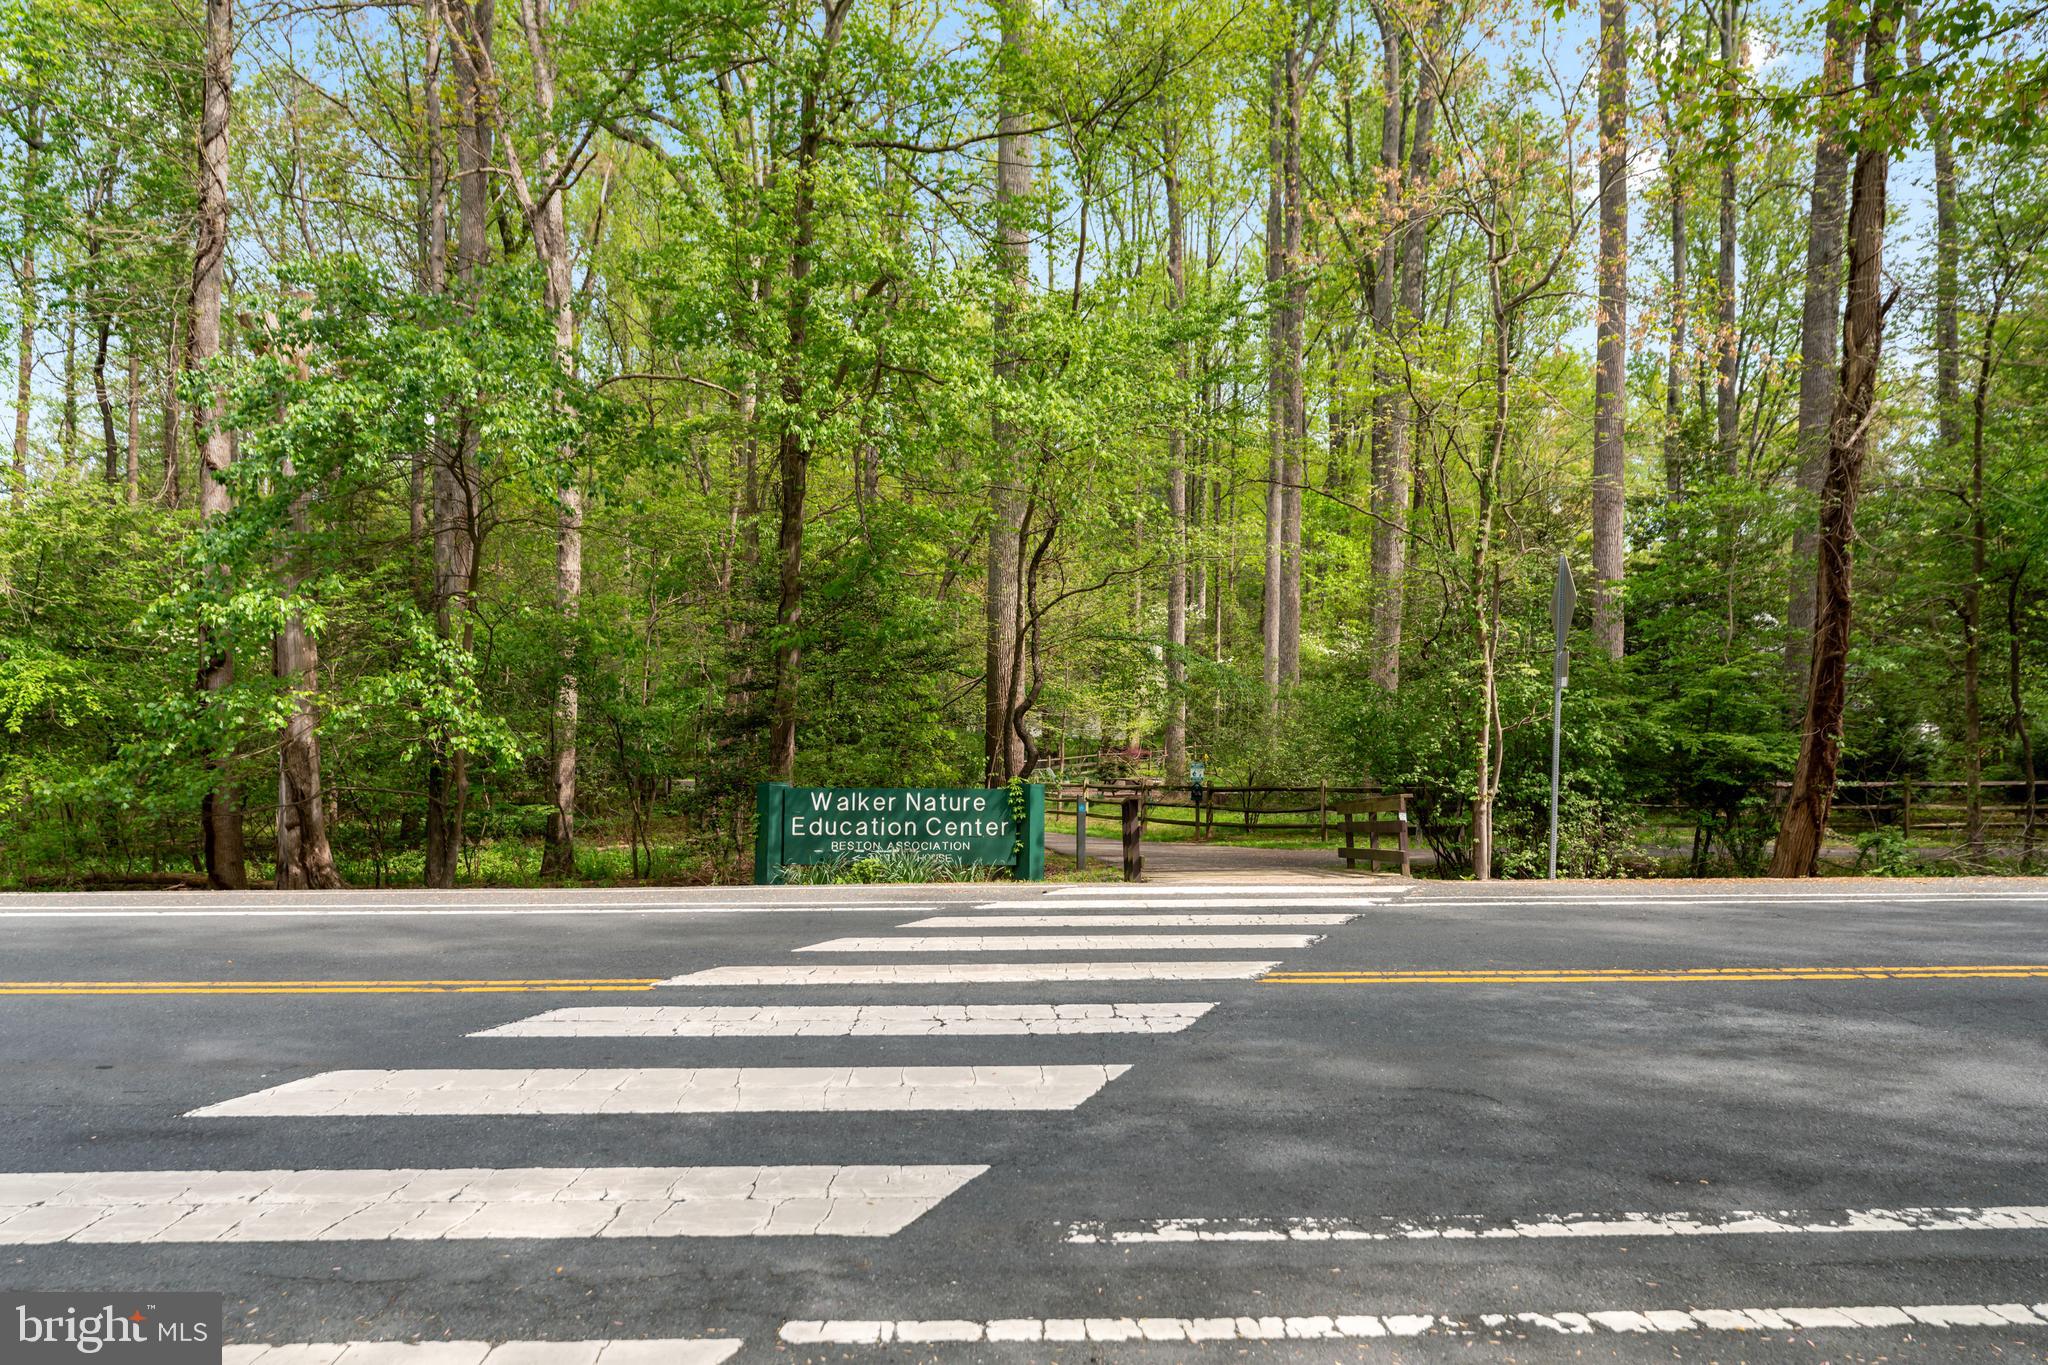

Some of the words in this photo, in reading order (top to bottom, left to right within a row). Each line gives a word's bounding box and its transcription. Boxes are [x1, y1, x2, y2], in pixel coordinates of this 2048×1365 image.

[810, 791, 897, 812] Walker
[906, 791, 987, 812] Nature
[791, 816, 917, 836] Education
[926, 816, 1009, 836] Center
[886, 841, 971, 851] ASSOCIATION
